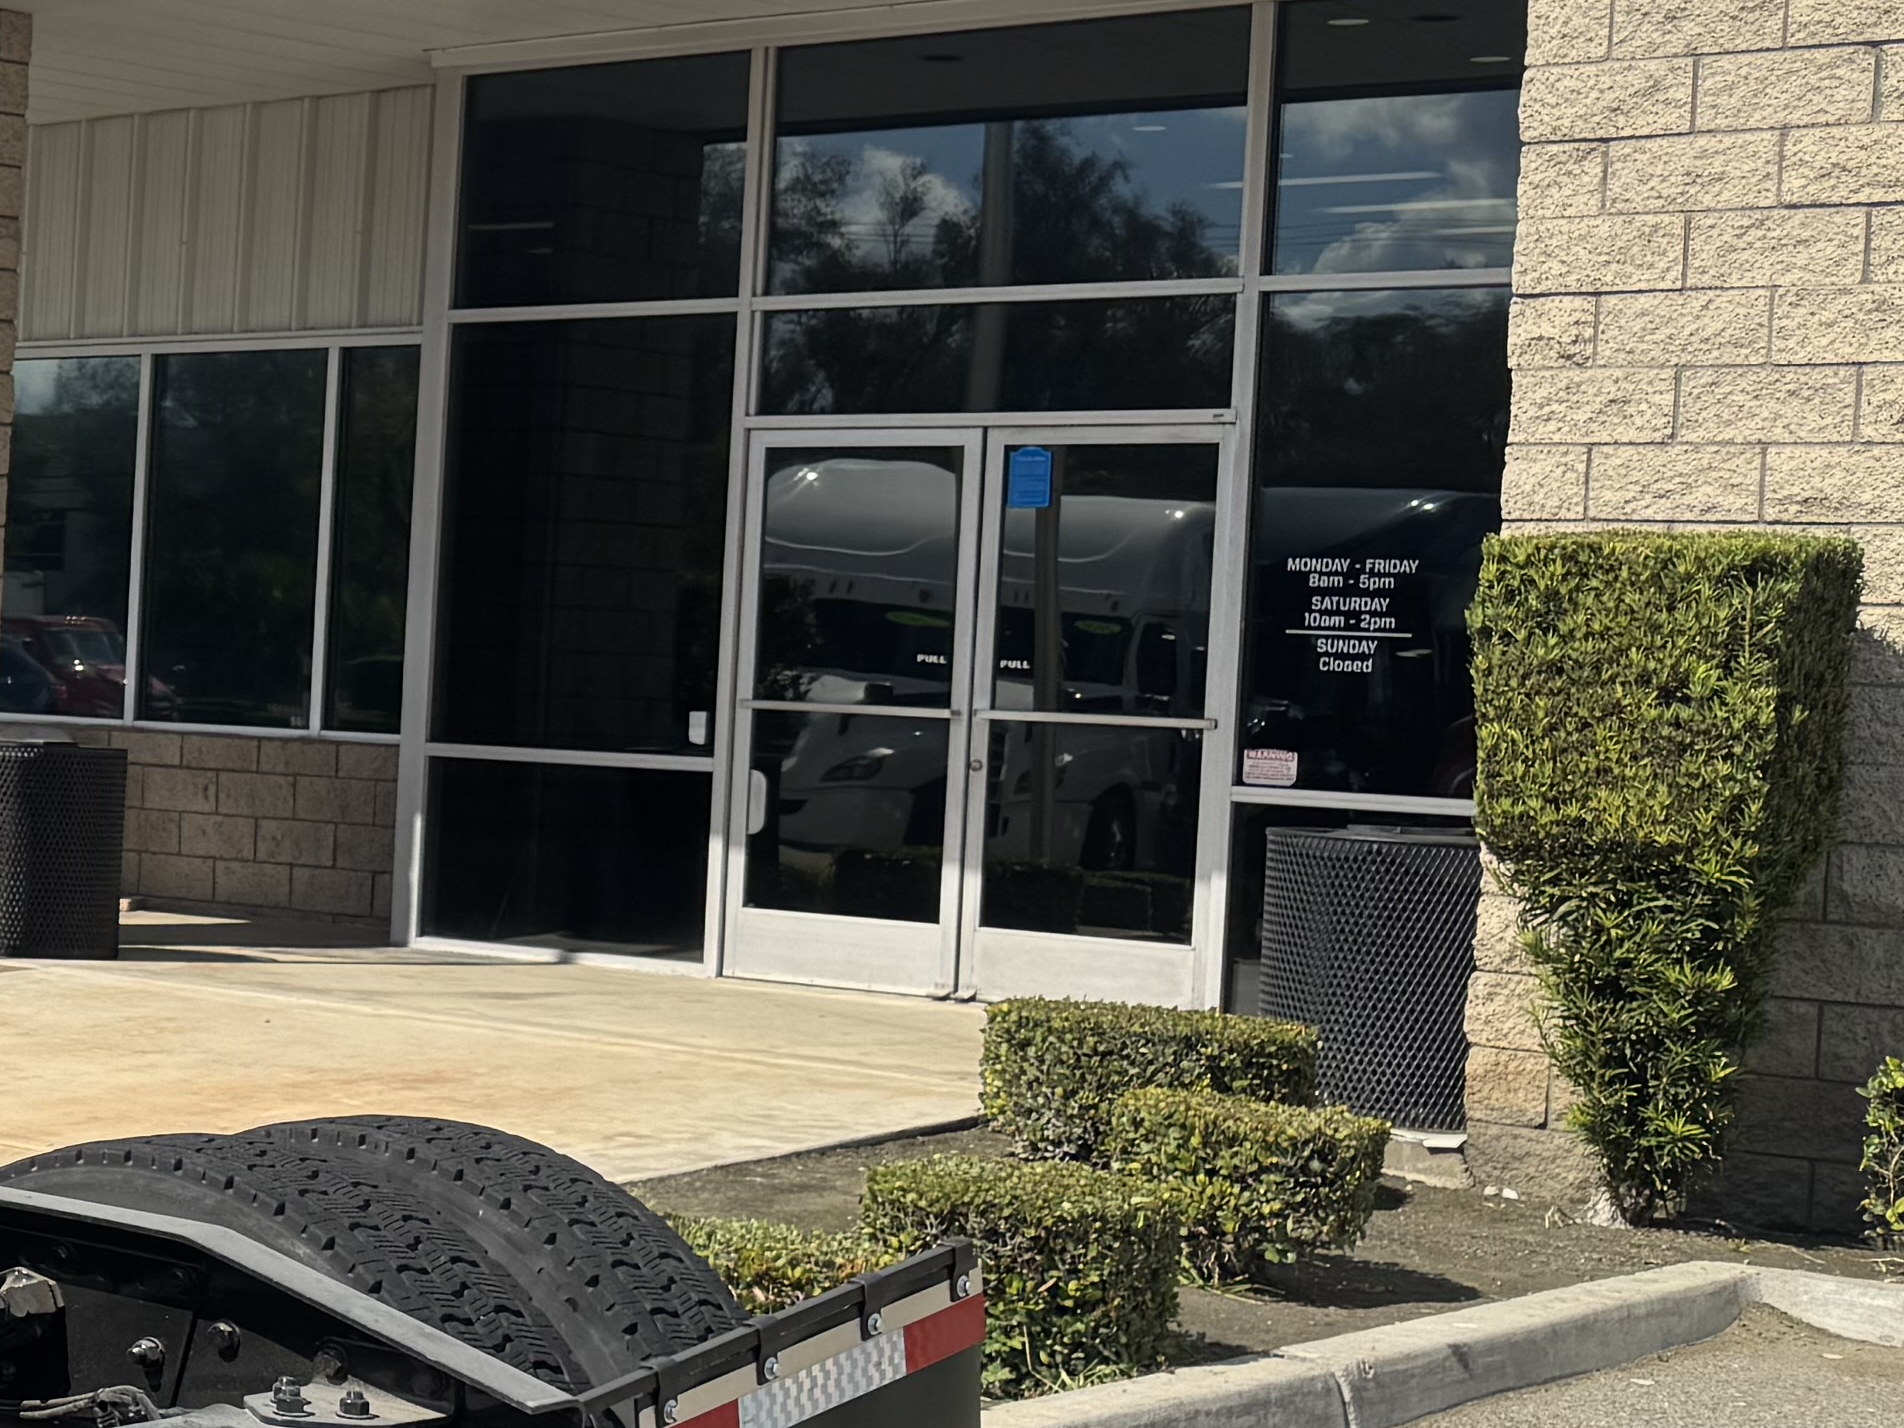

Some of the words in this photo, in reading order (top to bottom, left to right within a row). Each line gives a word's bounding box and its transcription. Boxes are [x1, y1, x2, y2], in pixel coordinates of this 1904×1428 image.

[1287, 557, 1350, 572] MONDAY
[1365, 558, 1419, 573] FRIDAY
[1309, 573, 1343, 588] 8am
[1359, 574, 1394, 591] 5pm
[1311, 596, 1389, 612] SATURDAY
[1304, 612, 1345, 628] 10am
[1360, 614, 1395, 631] 2pm
[1317, 638, 1378, 654] SUNDAY
[916, 654, 947, 664] PULL
[999, 659, 1030, 669] PULL
[1319, 656, 1373, 673] Closed
